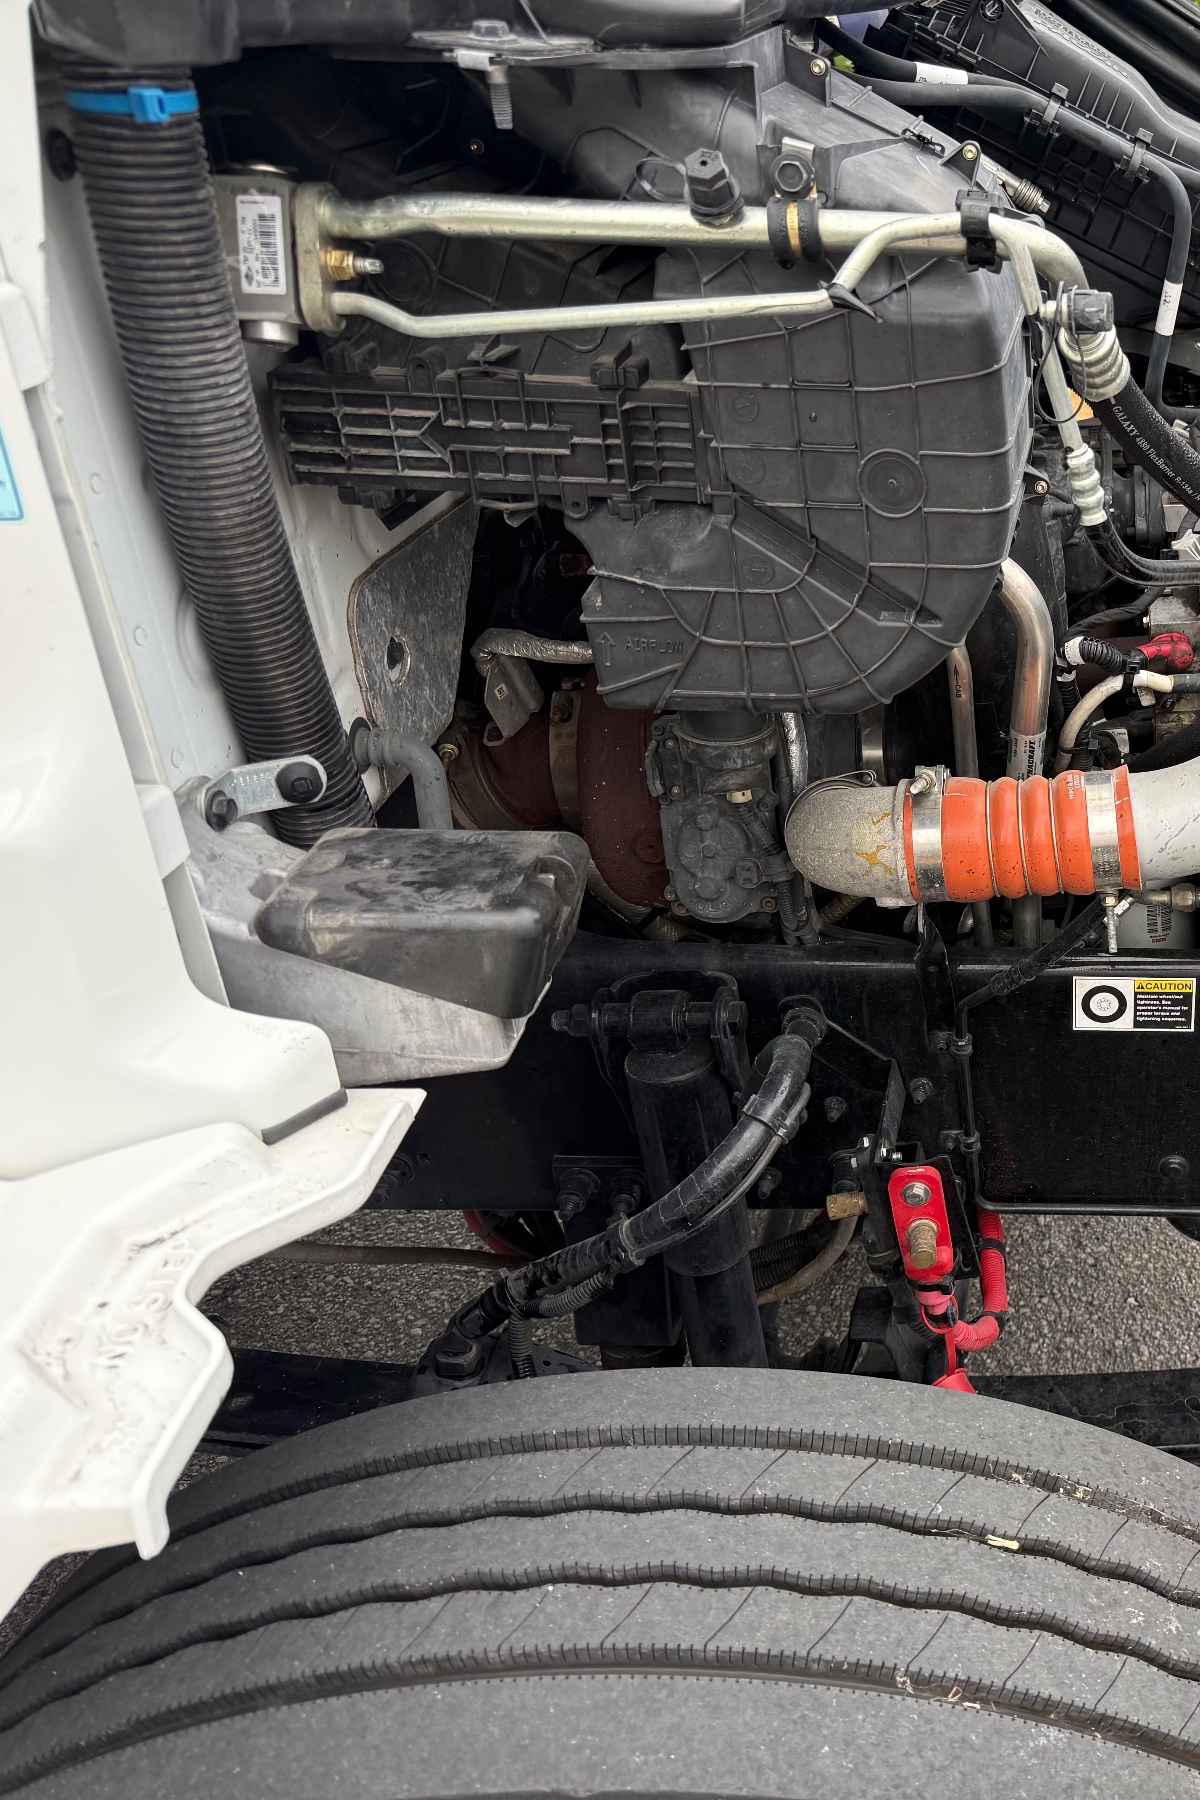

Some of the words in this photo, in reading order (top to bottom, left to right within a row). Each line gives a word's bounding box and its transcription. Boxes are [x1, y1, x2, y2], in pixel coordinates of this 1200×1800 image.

[1112, 405, 1140, 437] GALAXY
[1146, 448, 1176, 478] FlexBarrier
[624, 636, 684, 654] AIRFLOW
[1145, 982, 1192, 991] CAUTION
[91, 1321, 149, 1371] NO
[131, 1237, 197, 1315] STEP
